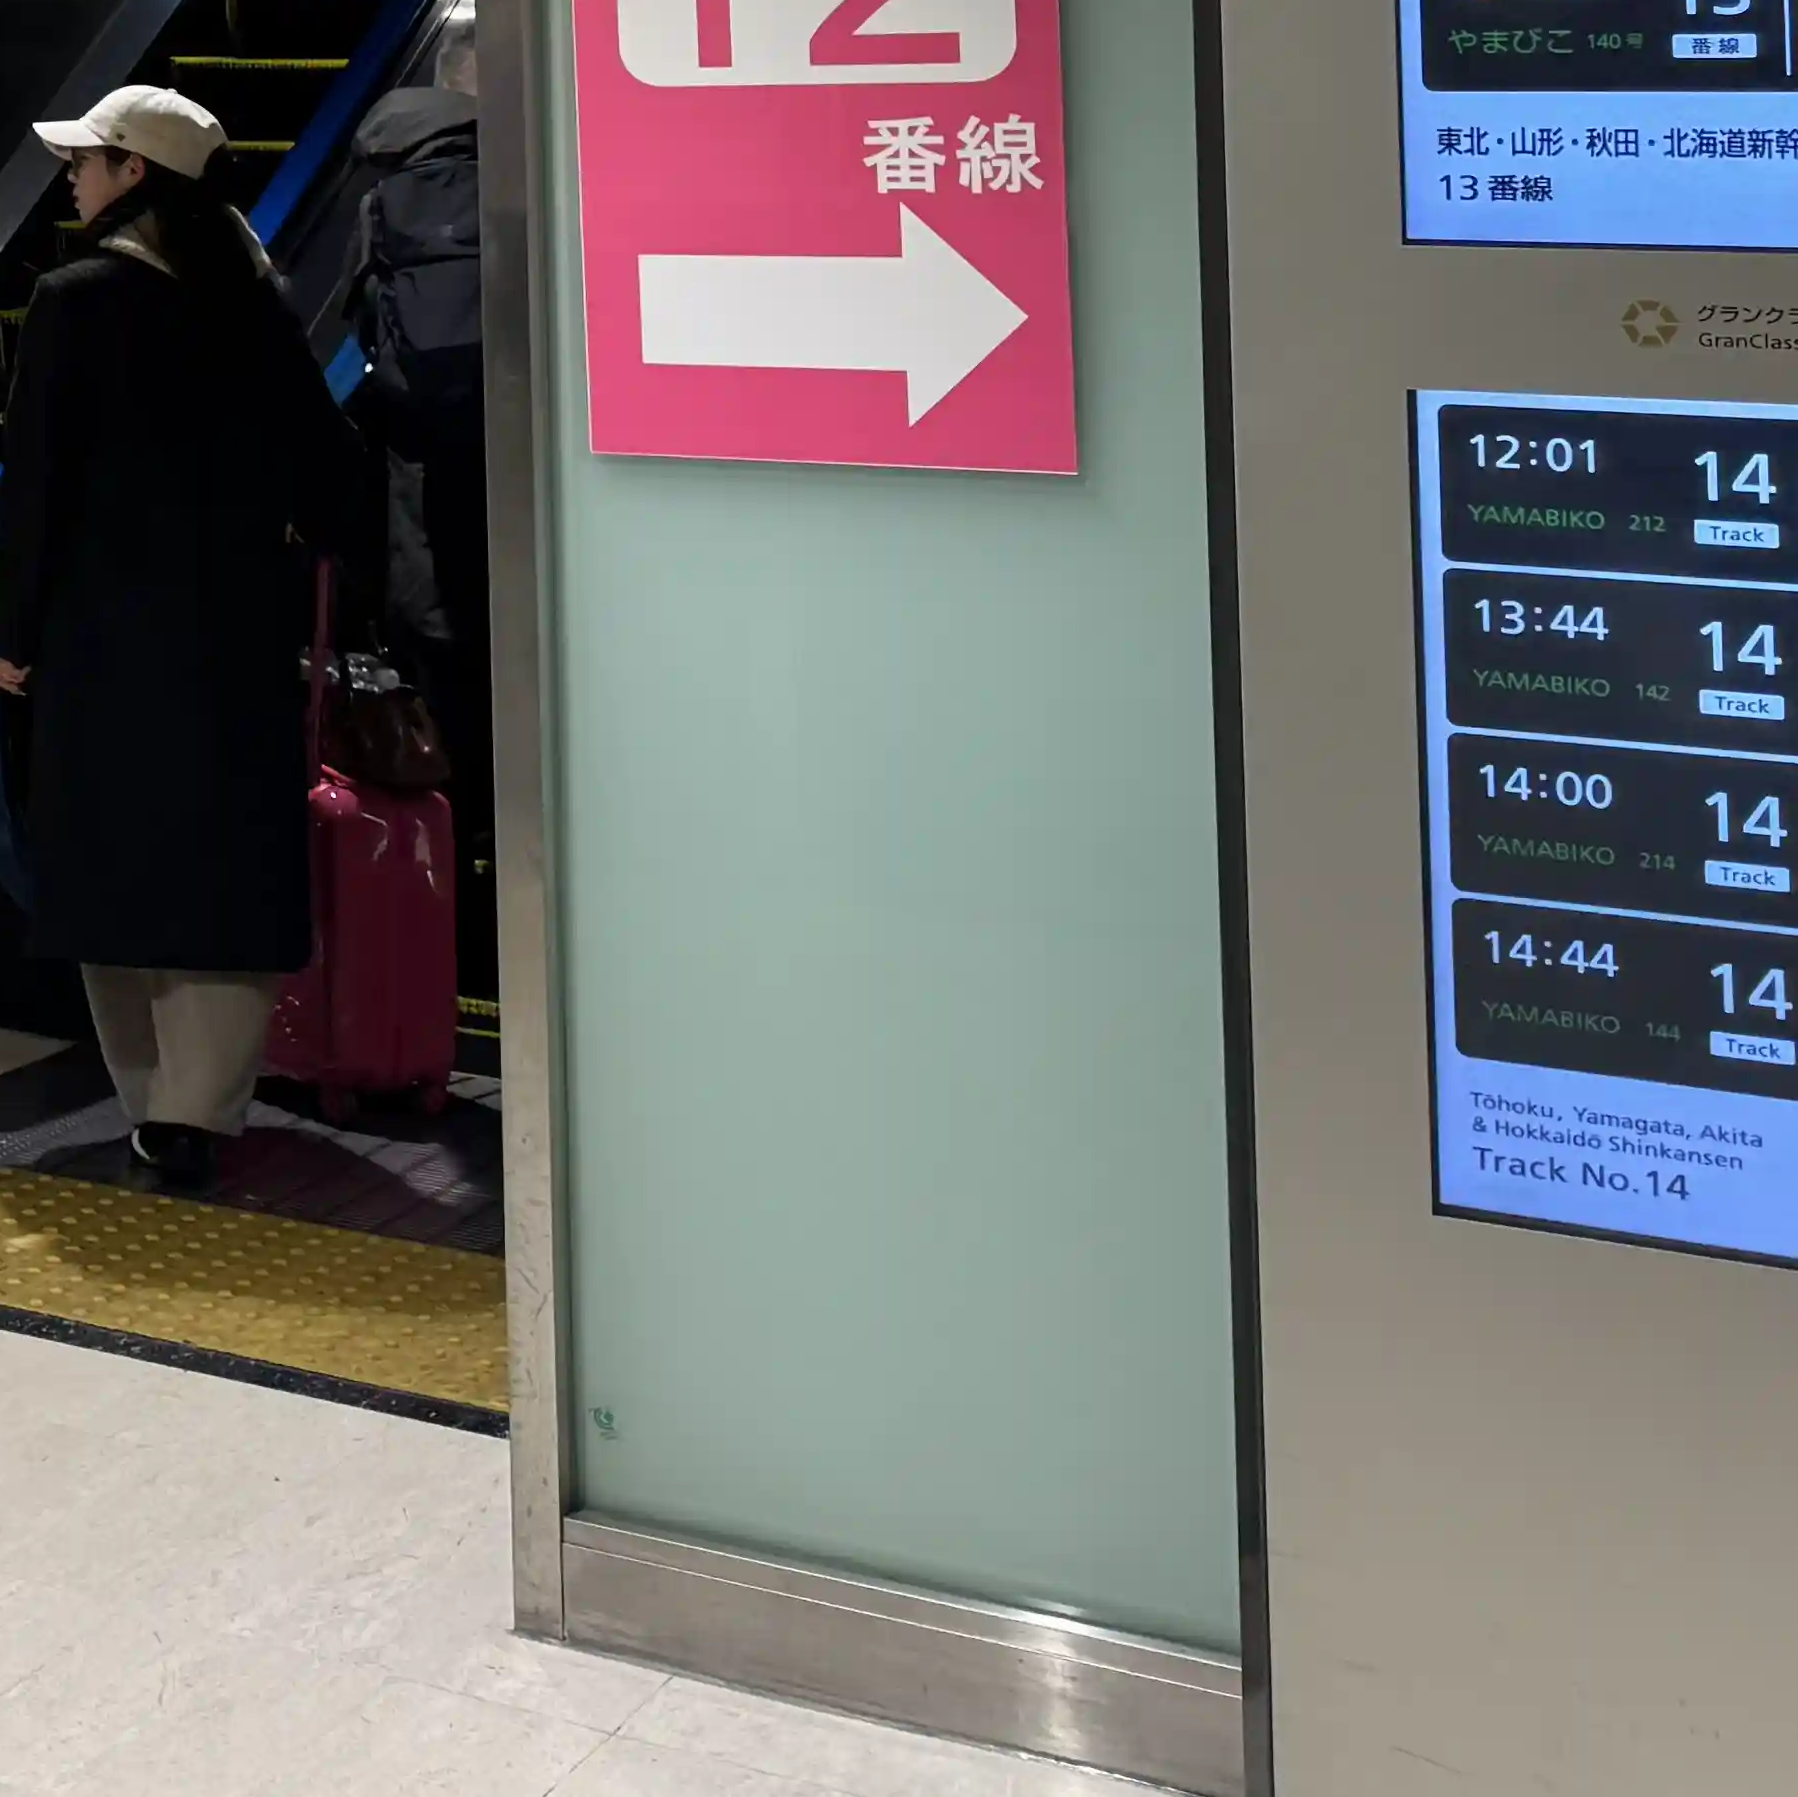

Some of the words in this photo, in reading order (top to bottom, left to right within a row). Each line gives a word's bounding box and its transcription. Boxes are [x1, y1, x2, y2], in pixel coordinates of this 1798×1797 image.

[1448, 30, 1573, 54] やまびこ
[1691, 38, 1739, 54] 番線
[862, 114, 1044, 194] 番線
[1469, 434, 1597, 473] 12:01
[1694, 451, 1777, 504] 14
[1467, 504, 1605, 530] YAMABIKO
[1629, 514, 1666, 532] 212
[1709, 525, 1764, 544] Track
[1474, 599, 1609, 640] 13:44
[1700, 621, 1782, 675] 14
[1473, 669, 1610, 698] YAMABIKO
[1636, 683, 1671, 702] 142
[1714, 695, 1769, 714] Track
[1479, 764, 1613, 809] 14:00
[1705, 791, 1788, 848] 14
[1477, 834, 1615, 866] YAMABIKO
[1640, 852, 1676, 871] 214
[1720, 866, 1776, 886] Track
[1484, 930, 1619, 977] 14:44
[1711, 963, 1792, 1020] 14
[1482, 1000, 1621, 1034] YAMABIKO
[1646, 1021, 1681, 1042] 144
[1725, 1038, 1781, 1059] Track
[1470, 1091, 1563, 1122] Tōhoku,
[1573, 1107, 1691, 1140] Yamagata,
[1701, 1123, 1763, 1148] Akita
[1472, 1116, 1487, 1133] &
[1495, 1120, 1601, 1150] Hokkaidō
[1609, 1137, 1743, 1170] Shinkansen
[1473, 1146, 1565, 1183] Track
